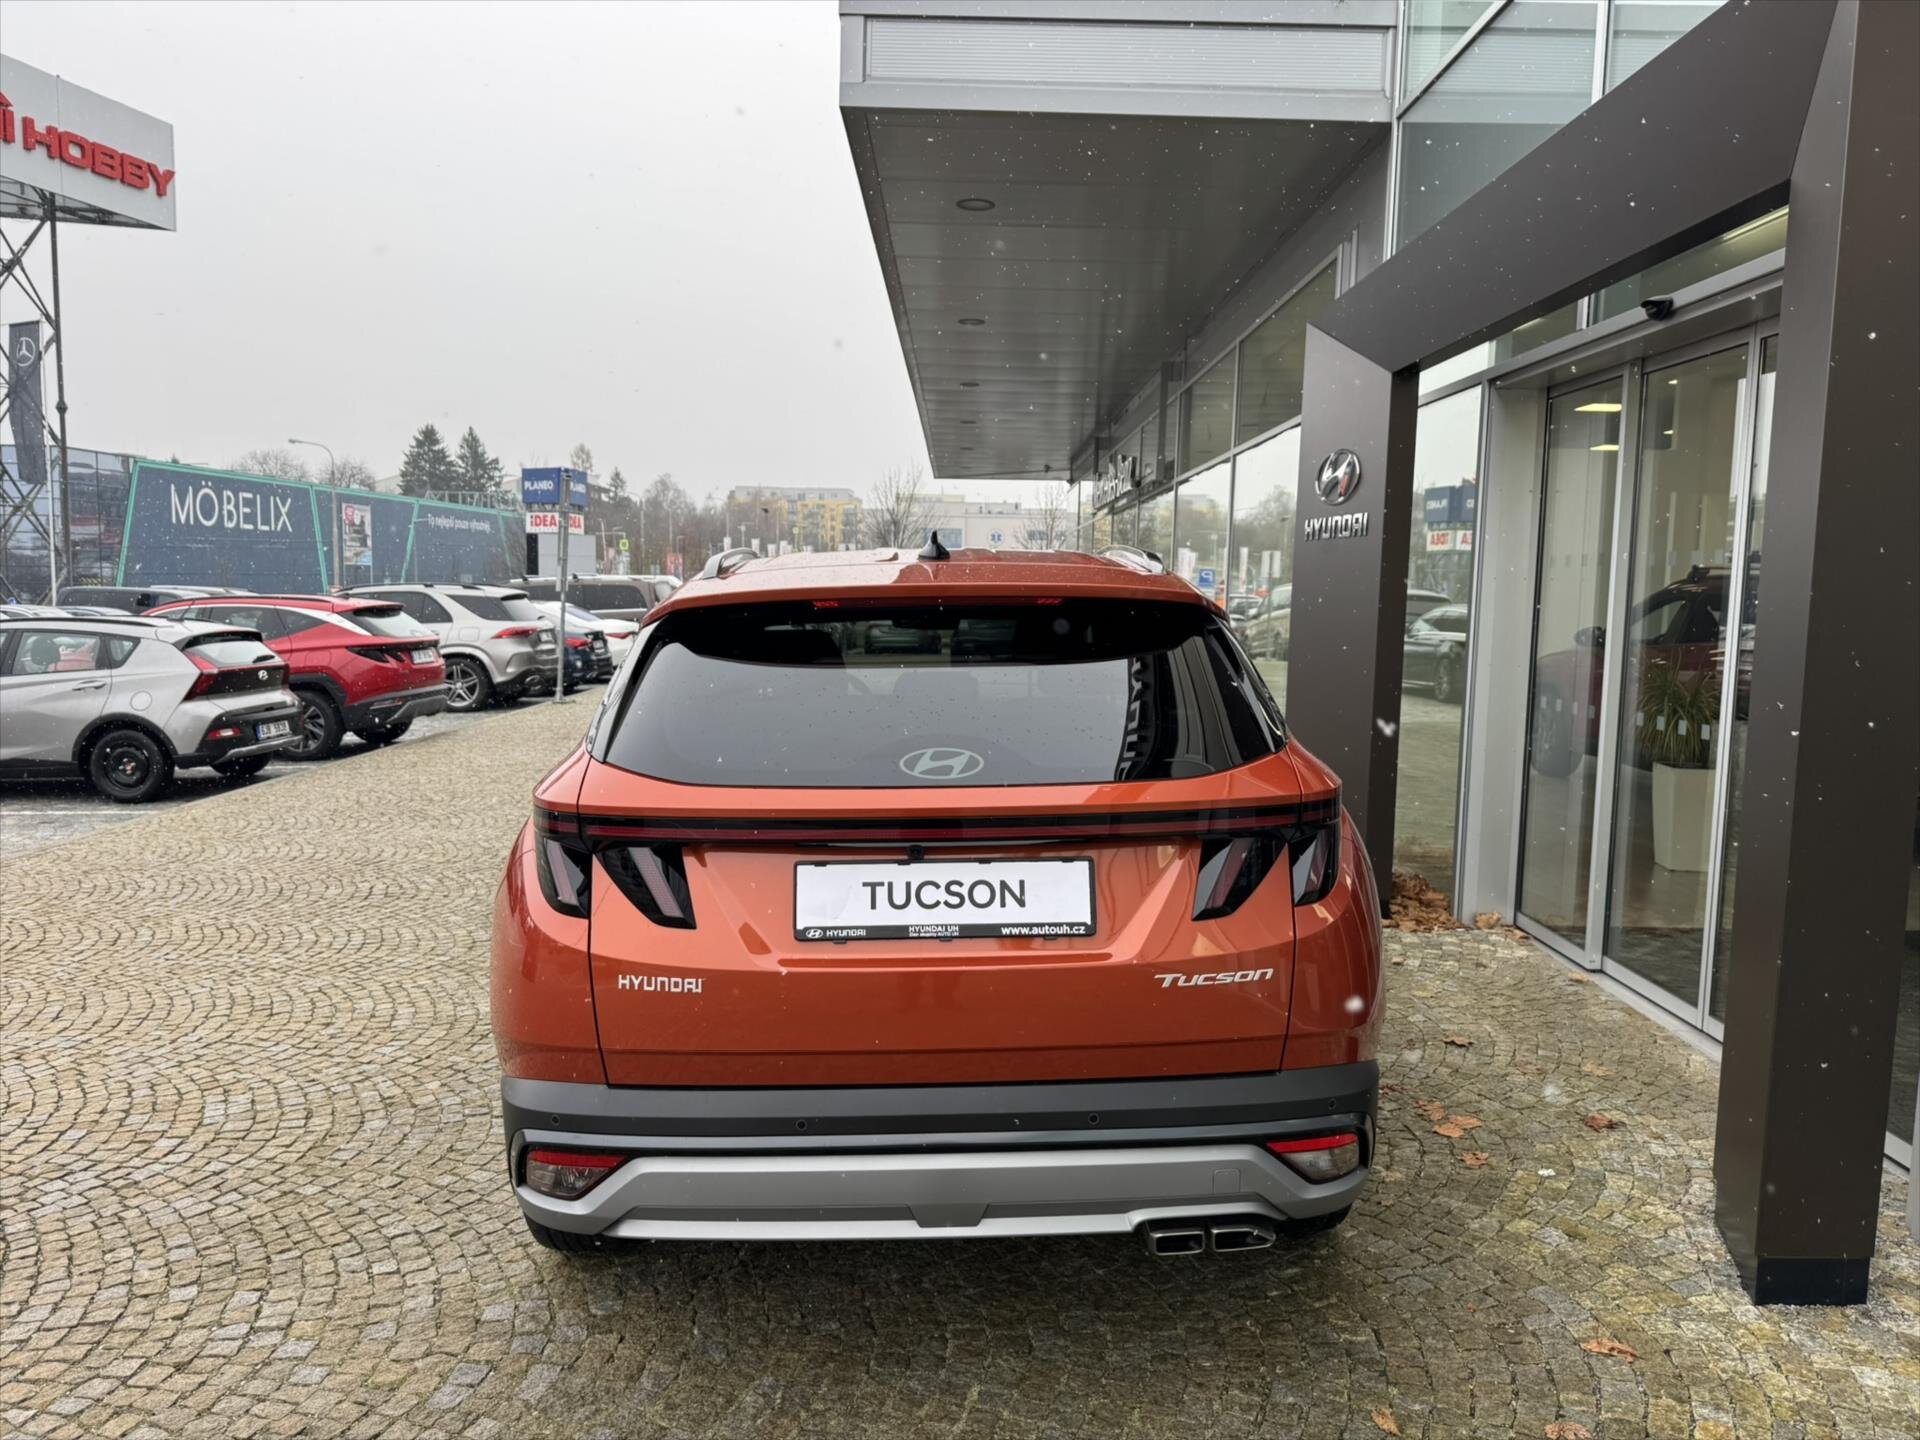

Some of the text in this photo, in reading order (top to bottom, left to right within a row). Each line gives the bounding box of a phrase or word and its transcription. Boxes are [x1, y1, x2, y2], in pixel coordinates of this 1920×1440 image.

[22, 116, 175, 197] HOBBY
[524, 480, 553, 490] PLANEO
[170, 480, 293, 532] MÖBELIX
[1304, 512, 1368, 541] HYUNDAI
[862, 879, 1026, 910] TUCSON
[826, 929, 866, 937] HYUNDAI
[909, 925, 945, 933] HYUNDAI
[1001, 924, 1086, 935] www.autouh.cz
[618, 974, 703, 993] HYUNDAI
